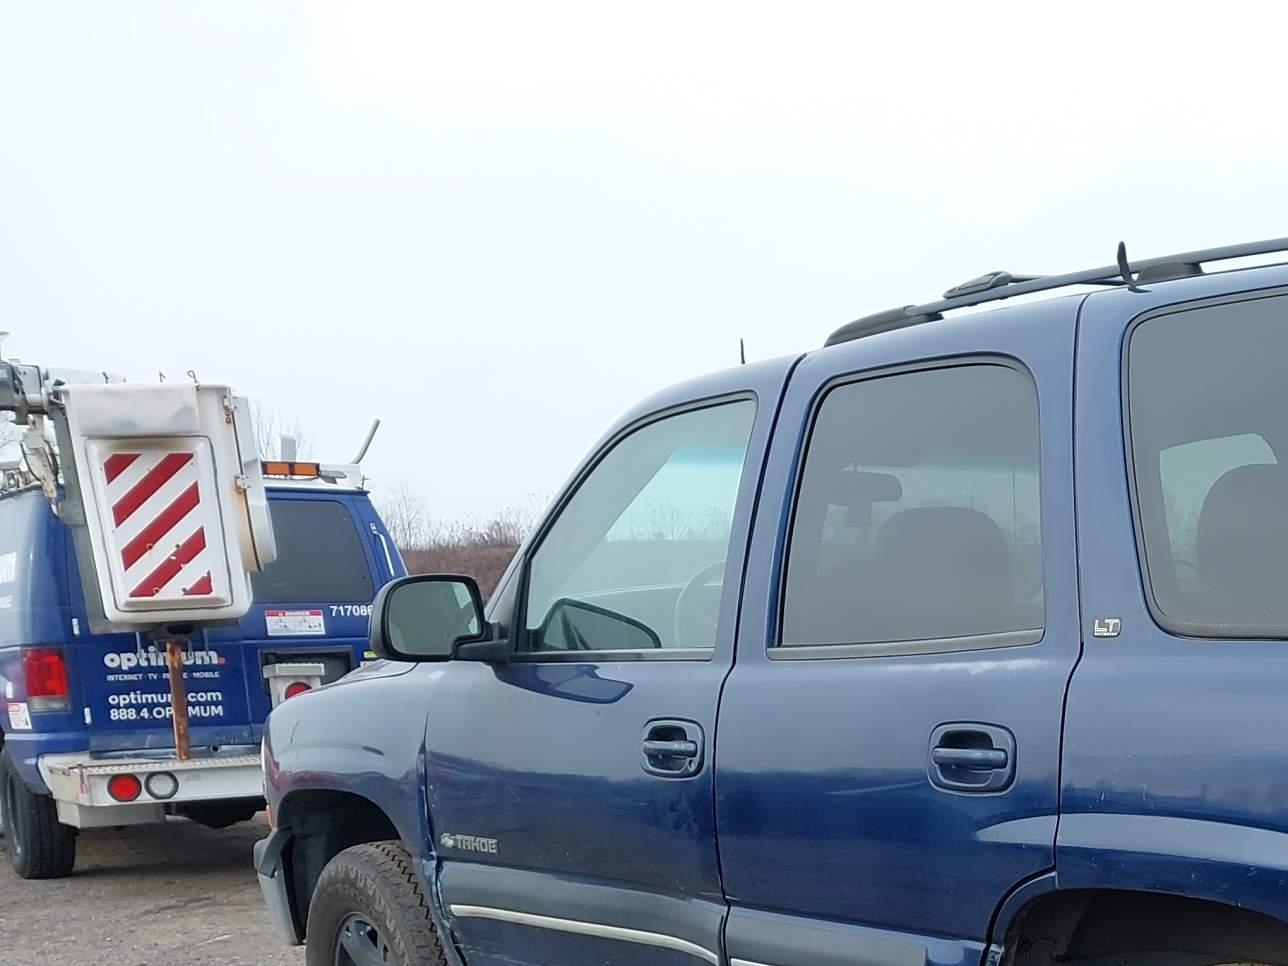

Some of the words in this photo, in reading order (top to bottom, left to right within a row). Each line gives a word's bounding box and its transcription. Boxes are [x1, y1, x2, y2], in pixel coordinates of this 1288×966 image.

[1094, 618, 1121, 636] LT
[107, 673, 143, 681] INTERNET
[148, 672, 158, 680] TV
[108, 690, 222, 707] optimucom
[110, 705, 223, 720] 888.4.OPMUM
[455, 834, 498, 853] TAHOE
